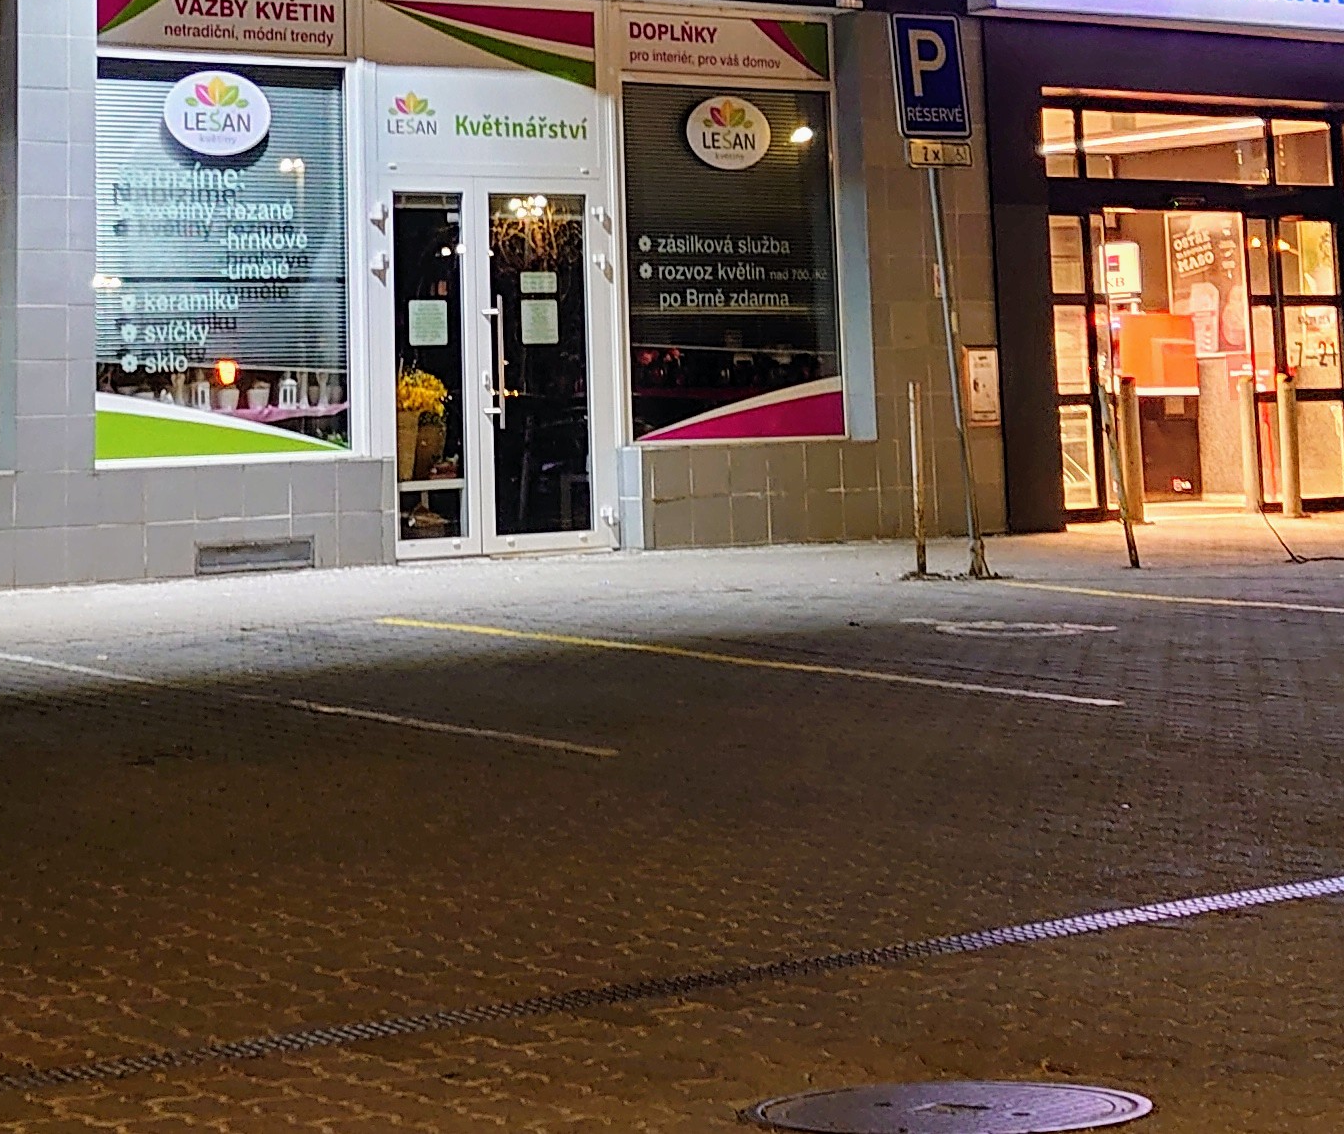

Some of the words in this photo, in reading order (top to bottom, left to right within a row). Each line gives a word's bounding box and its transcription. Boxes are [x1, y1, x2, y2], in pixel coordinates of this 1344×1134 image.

[164, 21, 239, 41] netradiční,
[243, 26, 288, 42] módní
[290, 28, 334, 46] trendy
[629, 20, 718, 44] DOPLŇKY
[630, 50, 649, 64] pro
[698, 53, 717, 67] pro
[720, 53, 740, 67] váš
[742, 55, 782, 69] domov
[908, 29, 947, 97] P
[455, 114, 588, 140] Květinářství
[656, 234, 734, 254] zásilková
[738, 236, 791, 254] služba
[658, 265, 713, 280] rozvoz
[717, 262, 766, 280] květin
[143, 289, 239, 311] keramiku
[659, 293, 682, 310] po
[686, 288, 725, 307] Brně
[729, 289, 790, 307] zdarma
[144, 317, 210, 346] svíčky
[144, 351, 189, 373] sklo
